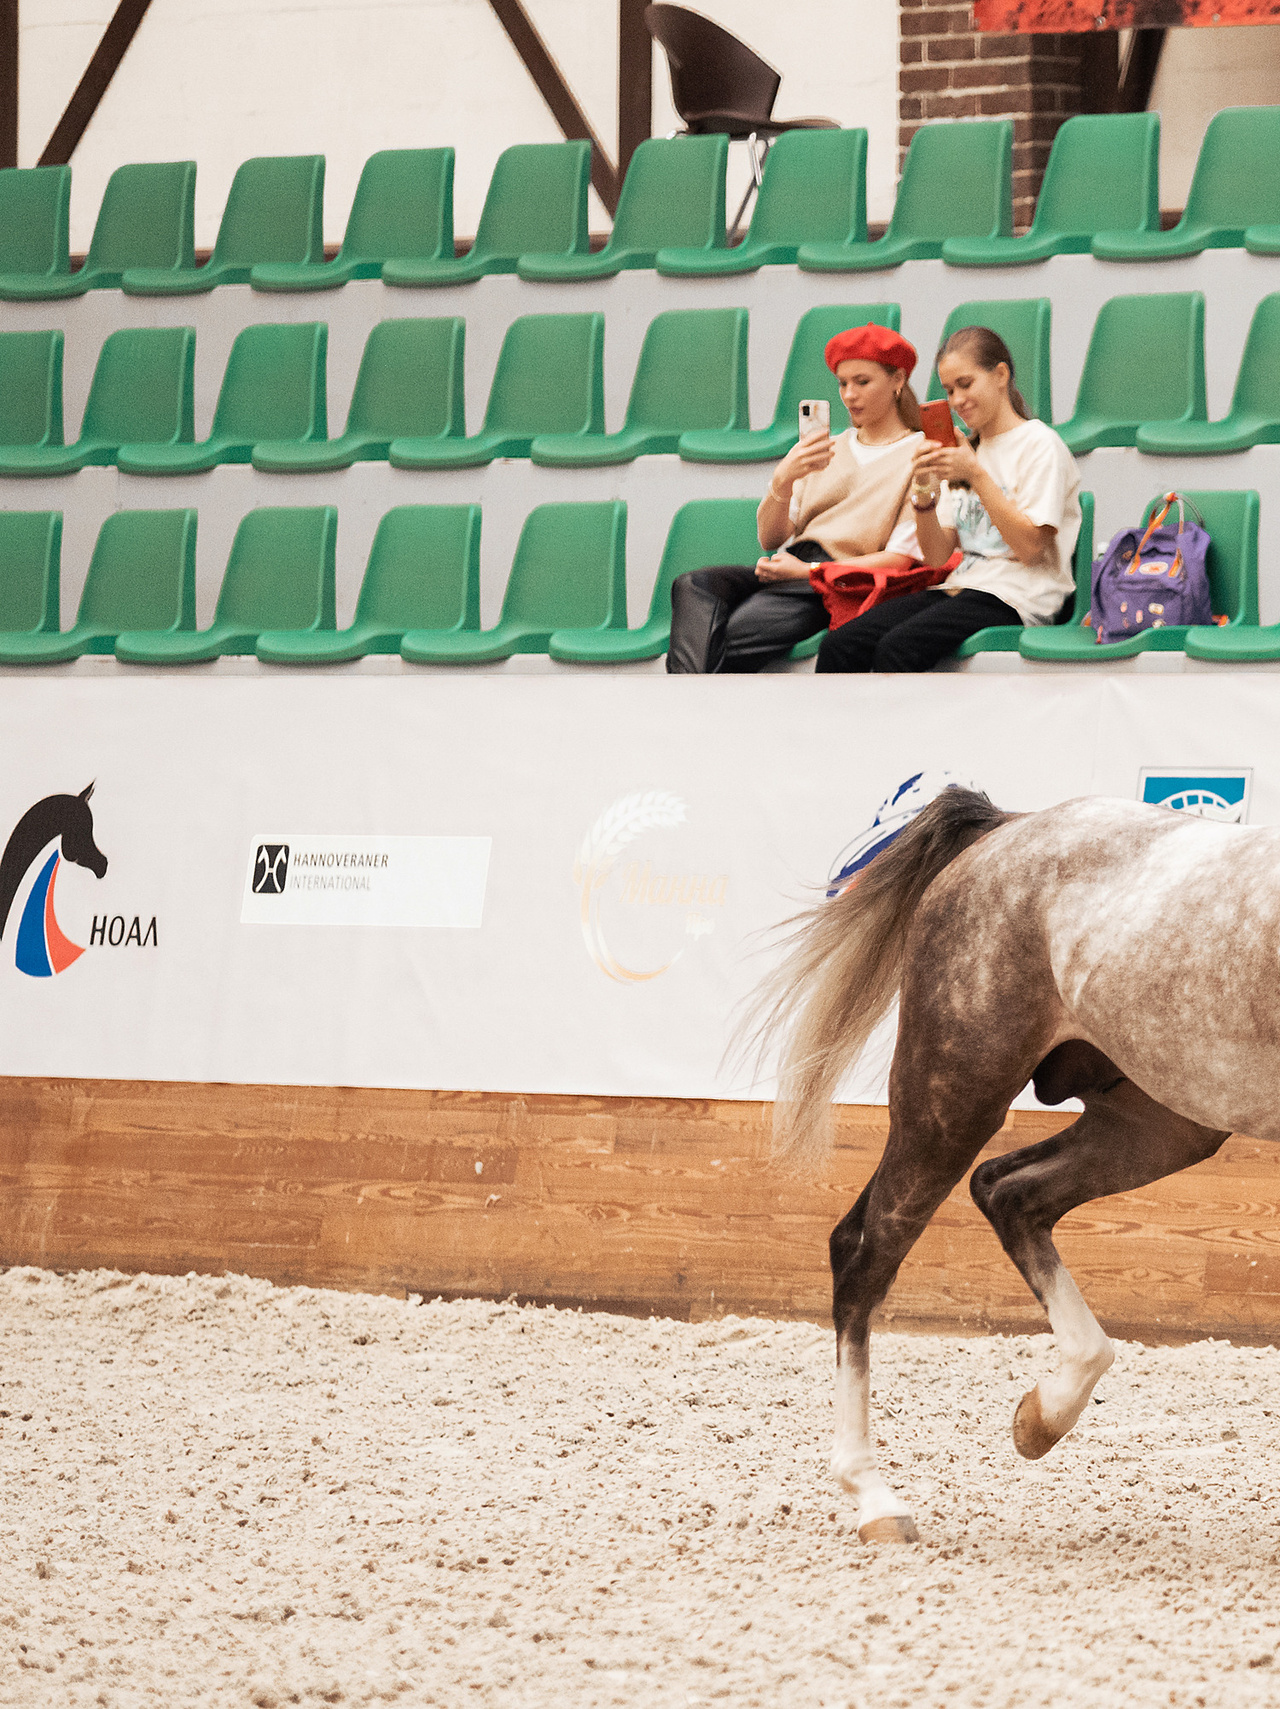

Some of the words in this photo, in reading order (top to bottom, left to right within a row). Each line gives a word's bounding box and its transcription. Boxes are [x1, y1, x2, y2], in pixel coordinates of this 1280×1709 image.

[293, 852, 389, 869] HANNOVERANER
[289, 874, 371, 891] INTERNATIONAL
[619, 859, 729, 905] Манна
